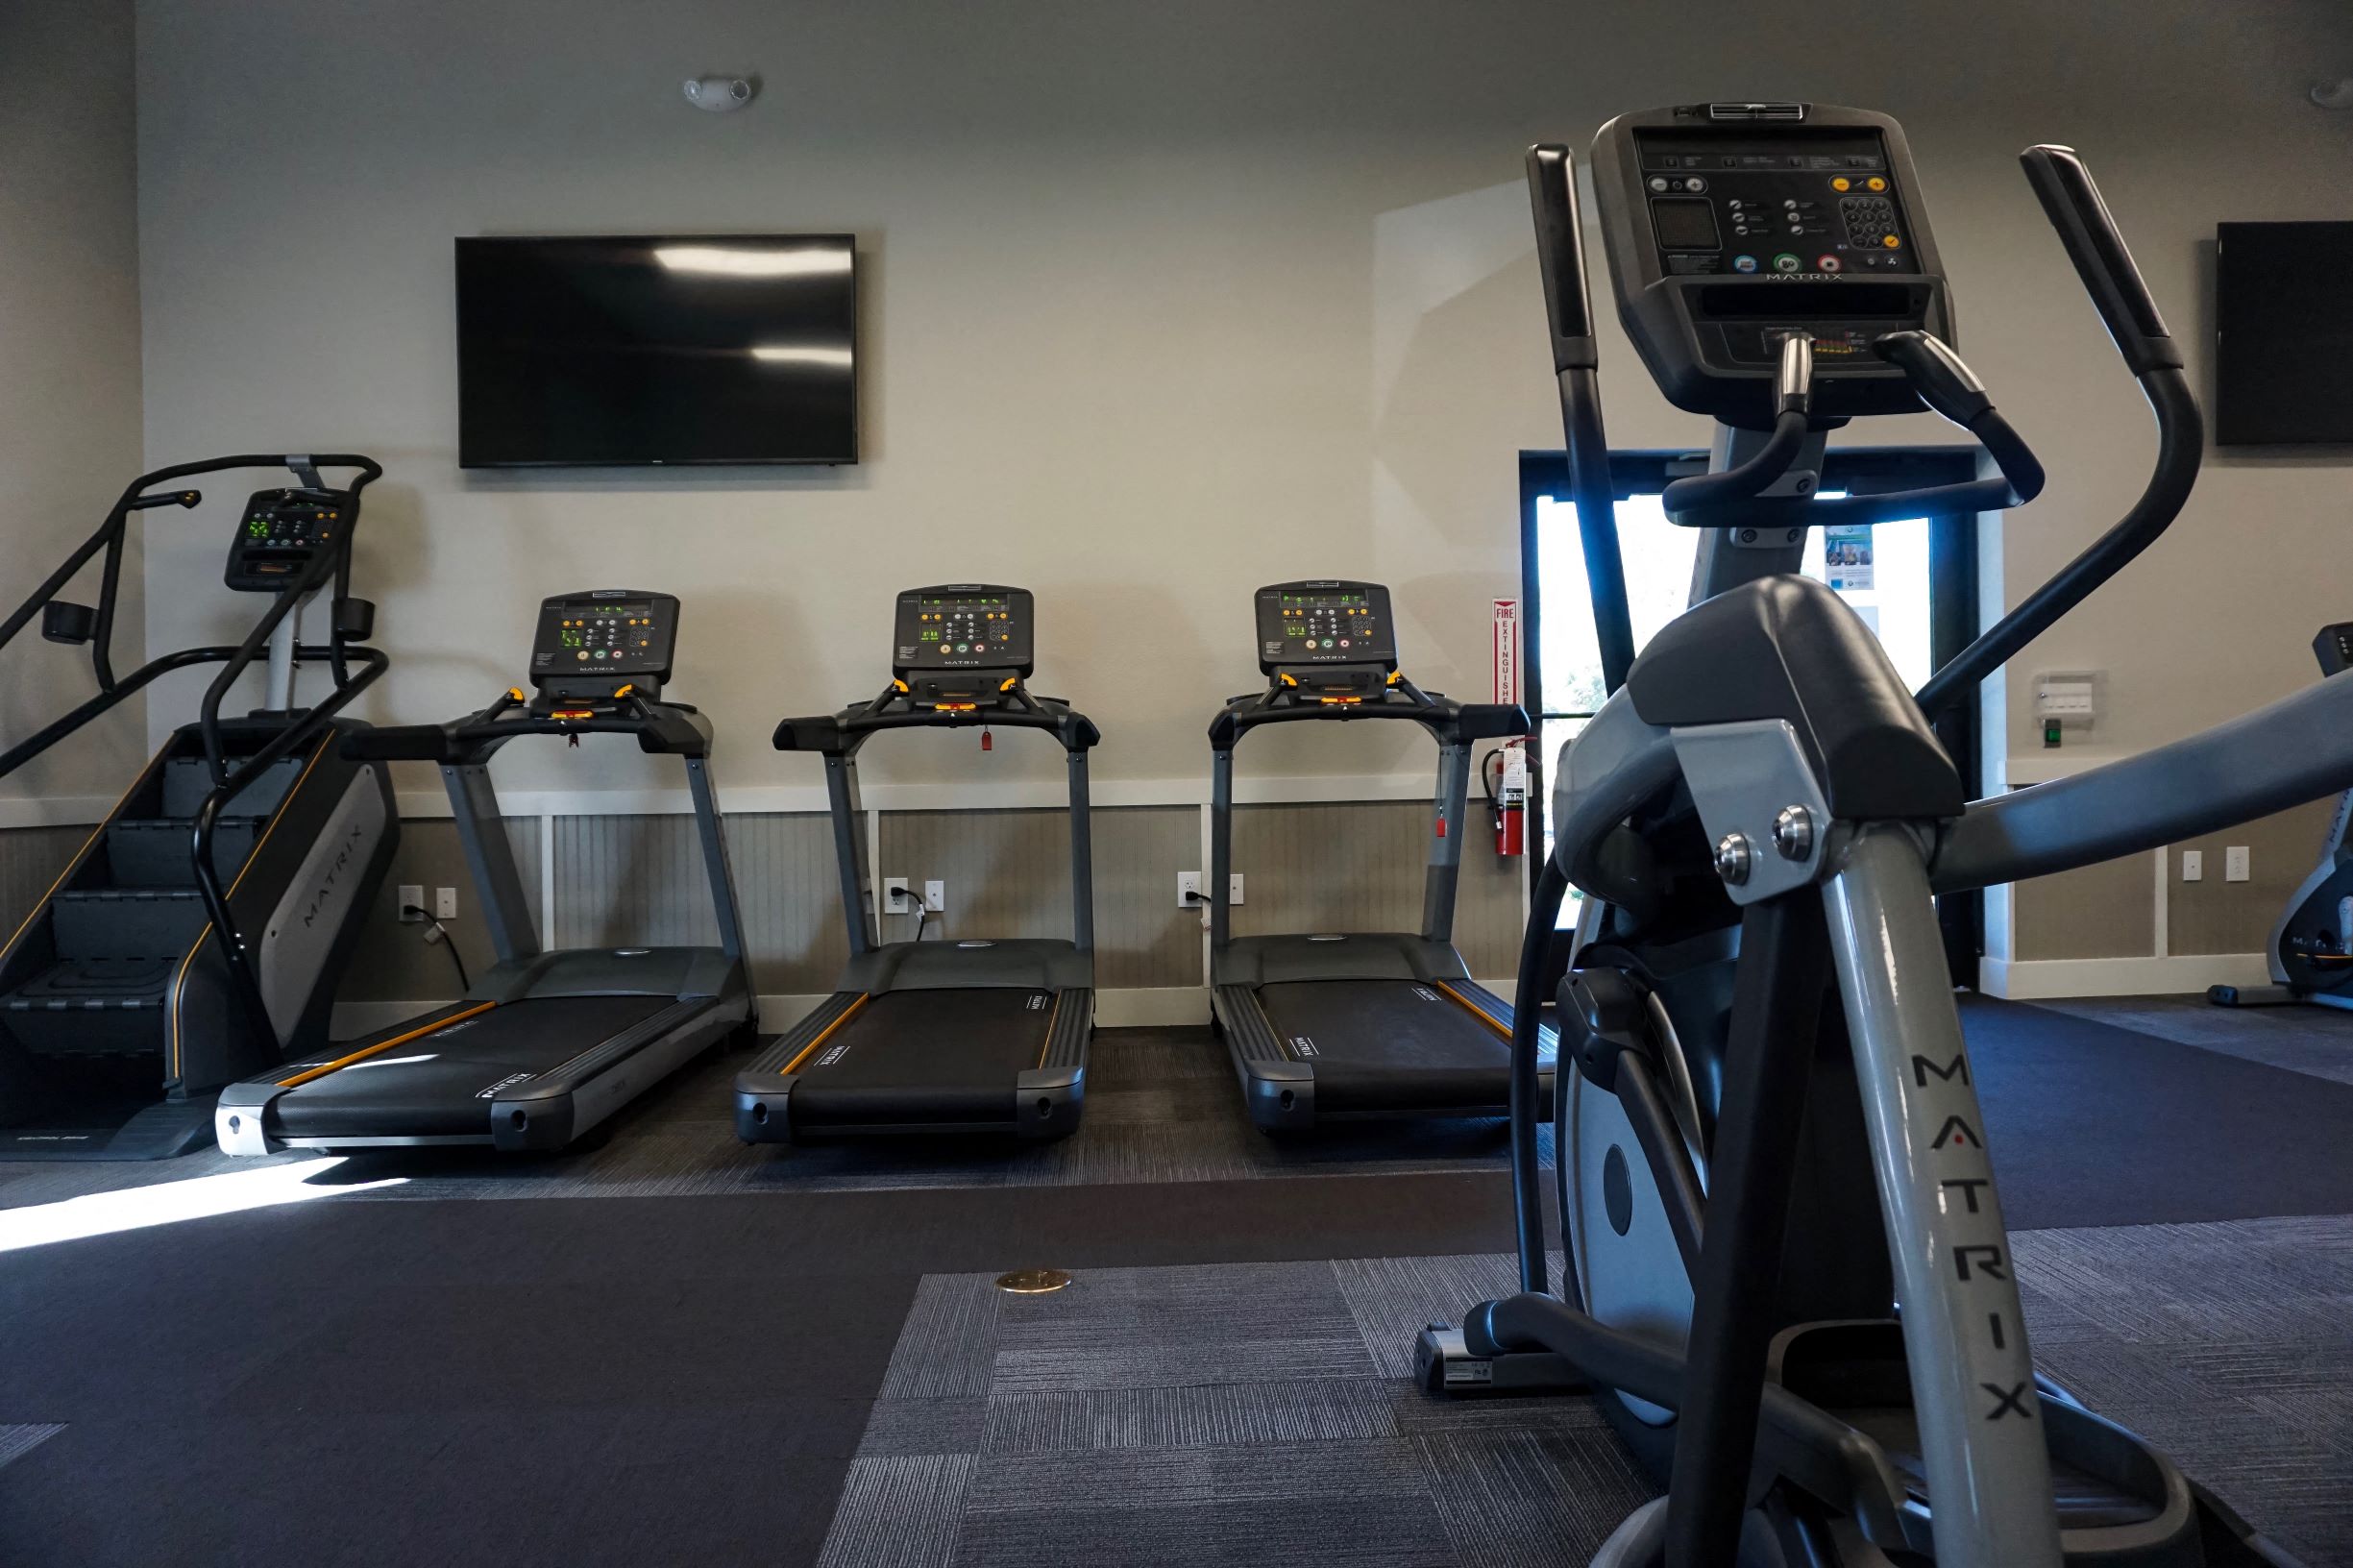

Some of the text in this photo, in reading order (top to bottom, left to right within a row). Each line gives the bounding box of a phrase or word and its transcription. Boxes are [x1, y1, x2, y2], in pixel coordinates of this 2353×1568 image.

[1496, 608, 1514, 619] FIRE
[303, 823, 362, 928] MATRIX
[1294, 1037, 1313, 1056] MATRIX
[481, 1073, 531, 1099] MATRIX
[1912, 1054, 2033, 1420] MATRIX
